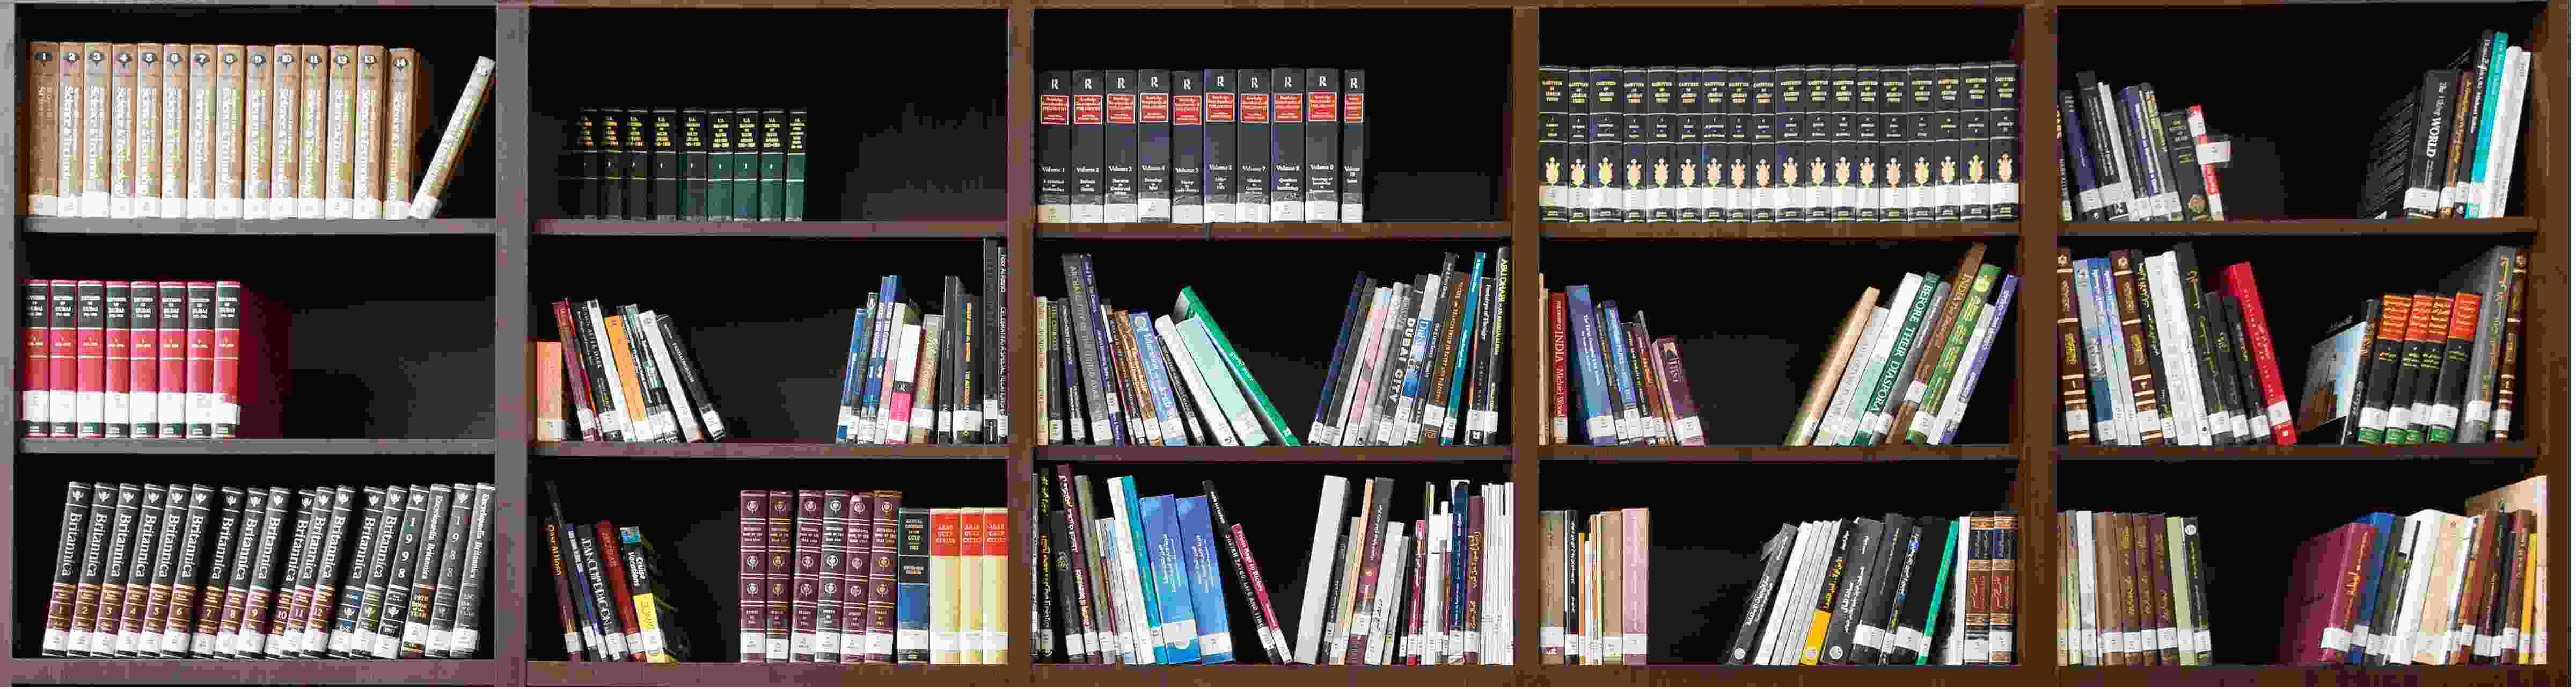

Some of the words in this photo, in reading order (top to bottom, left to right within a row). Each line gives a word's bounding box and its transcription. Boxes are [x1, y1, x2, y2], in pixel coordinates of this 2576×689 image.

[69, 52, 76, 61] 2
[93, 52, 101, 61] 3
[120, 54, 128, 62] 4
[146, 53, 155, 61] 5
[198, 54, 206, 62] 7
[255, 56, 261, 64] 9
[281, 55, 293, 63] 10
[310, 55, 318, 64] 11
[363, 55, 374, 63] 13
[1051, 79, 1060, 90] R
[1084, 78, 1092, 90] R
[1117, 78, 1125, 89] R
[1151, 77, 1159, 88] R
[1183, 79, 1191, 90] R
[1216, 76, 1224, 87] R
[1250, 77, 1258, 88] R
[1284, 77, 1292, 88] R
[1319, 76, 1327, 86] R
[1350, 78, 1358, 89] R
[2426, 116, 2441, 158] WORLD
[1498, 277, 1507, 302] DHABI
[1909, 283, 1933, 322] BEFORE
[1399, 318, 1416, 361] DUBAI
[1894, 326, 1915, 358] THEIR
[1554, 330, 1564, 364] INDIA
[1389, 369, 1404, 402] CITY
[1555, 368, 1564, 395] Michael
[1871, 360, 1900, 412] DIASPORA
[1555, 396, 1564, 417] Wood
[61, 513, 82, 577] Britannica
[86, 513, 108, 577] Britannica
[111, 514, 132, 577] Britannica
[135, 514, 157, 578] Britannica
[158, 514, 181, 578] Britannica
[182, 514, 205, 578] Britannica
[211, 517, 235, 581] Britannica
[235, 518, 258, 581] Britannica
[258, 517, 281, 580] Britannica
[285, 519, 309, 582] Britannica
[303, 516, 326, 579] Britannica
[321, 515, 346, 578] Britannica
[352, 516, 376, 580] Britannica
[372, 515, 397, 578] Britannica
[627, 551, 640, 587] Vacations
[635, 556, 646, 579] Cruise
[58, 606, 63, 615] 1
[82, 606, 89, 615] 2
[106, 606, 112, 615] 3
[129, 607, 136, 615] 4
[153, 607, 159, 615] 5
[176, 606, 182, 615] 6
[230, 610, 236, 618] 8
[252, 608, 258, 617] 9
[277, 611, 287, 619] 10
[295, 609, 304, 617] 11
[313, 607, 323, 617] 12
